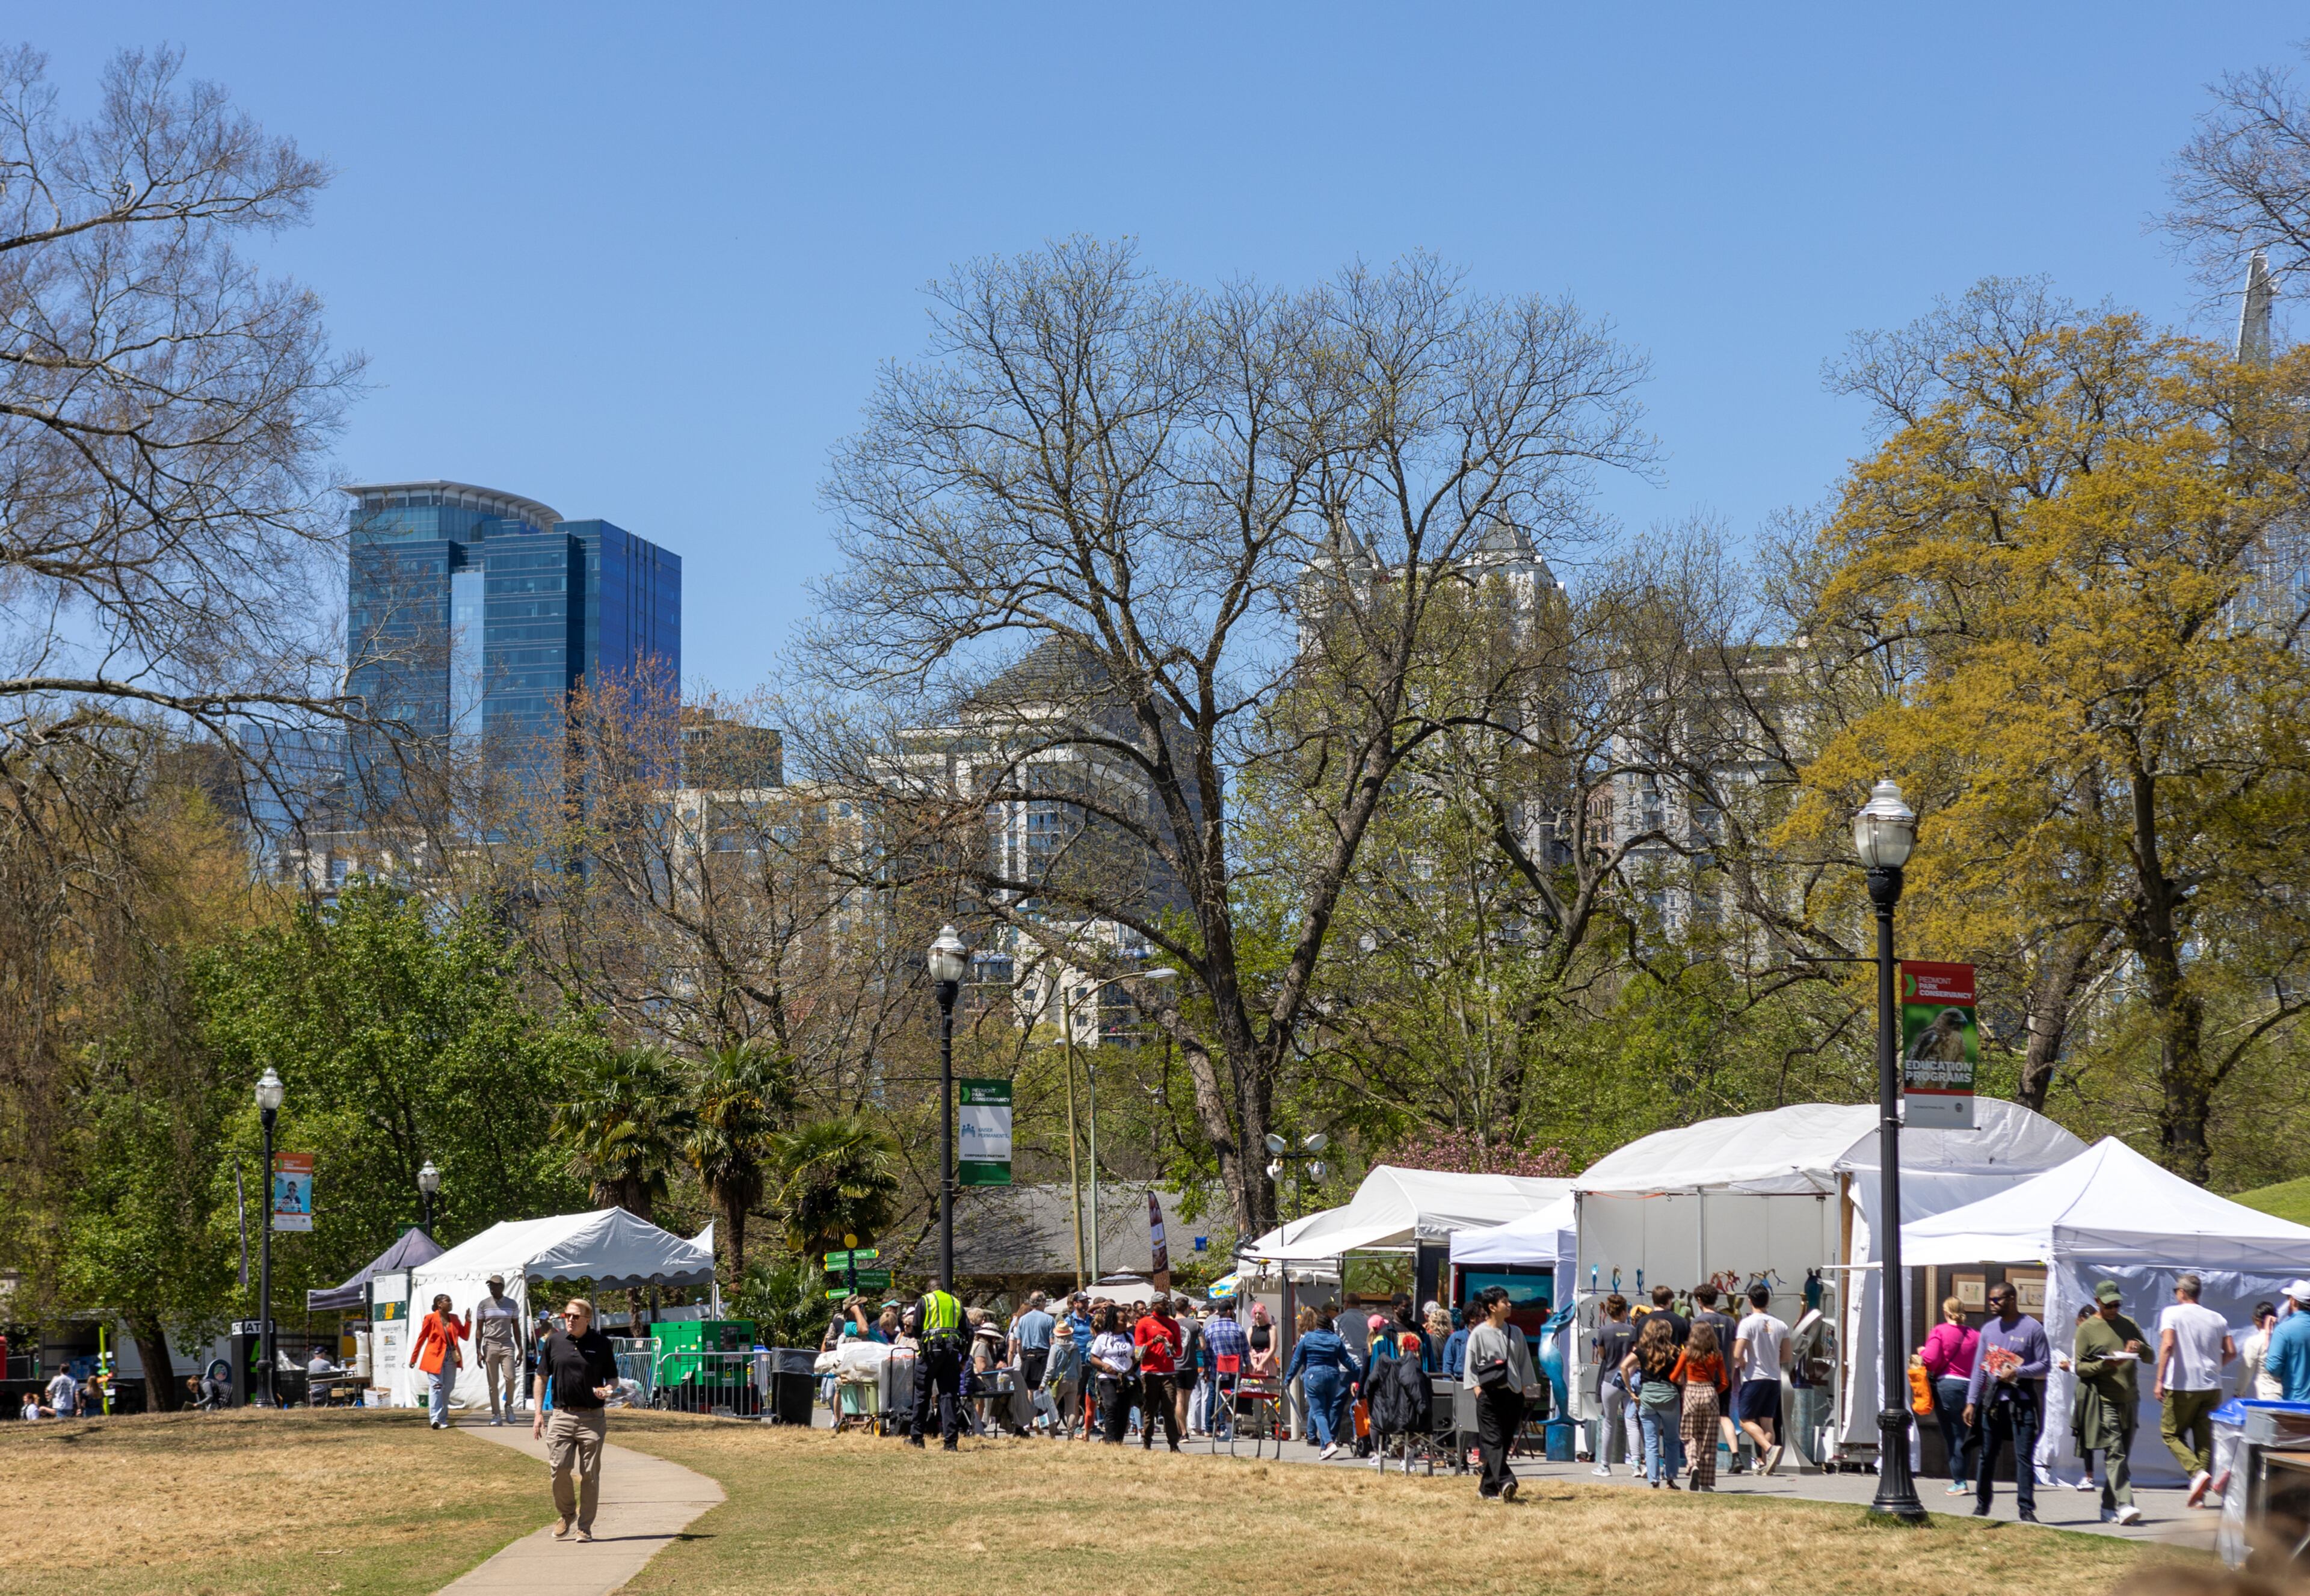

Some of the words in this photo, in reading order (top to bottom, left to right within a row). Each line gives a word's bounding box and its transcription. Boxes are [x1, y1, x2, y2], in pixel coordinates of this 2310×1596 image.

[1918, 976, 1952, 984] PIEDMONT
[1919, 990, 1973, 999] CONSERVANCY
[1905, 1060, 1973, 1072] EDUCATION
[1905, 1071, 1973, 1083] PROGRAMS
